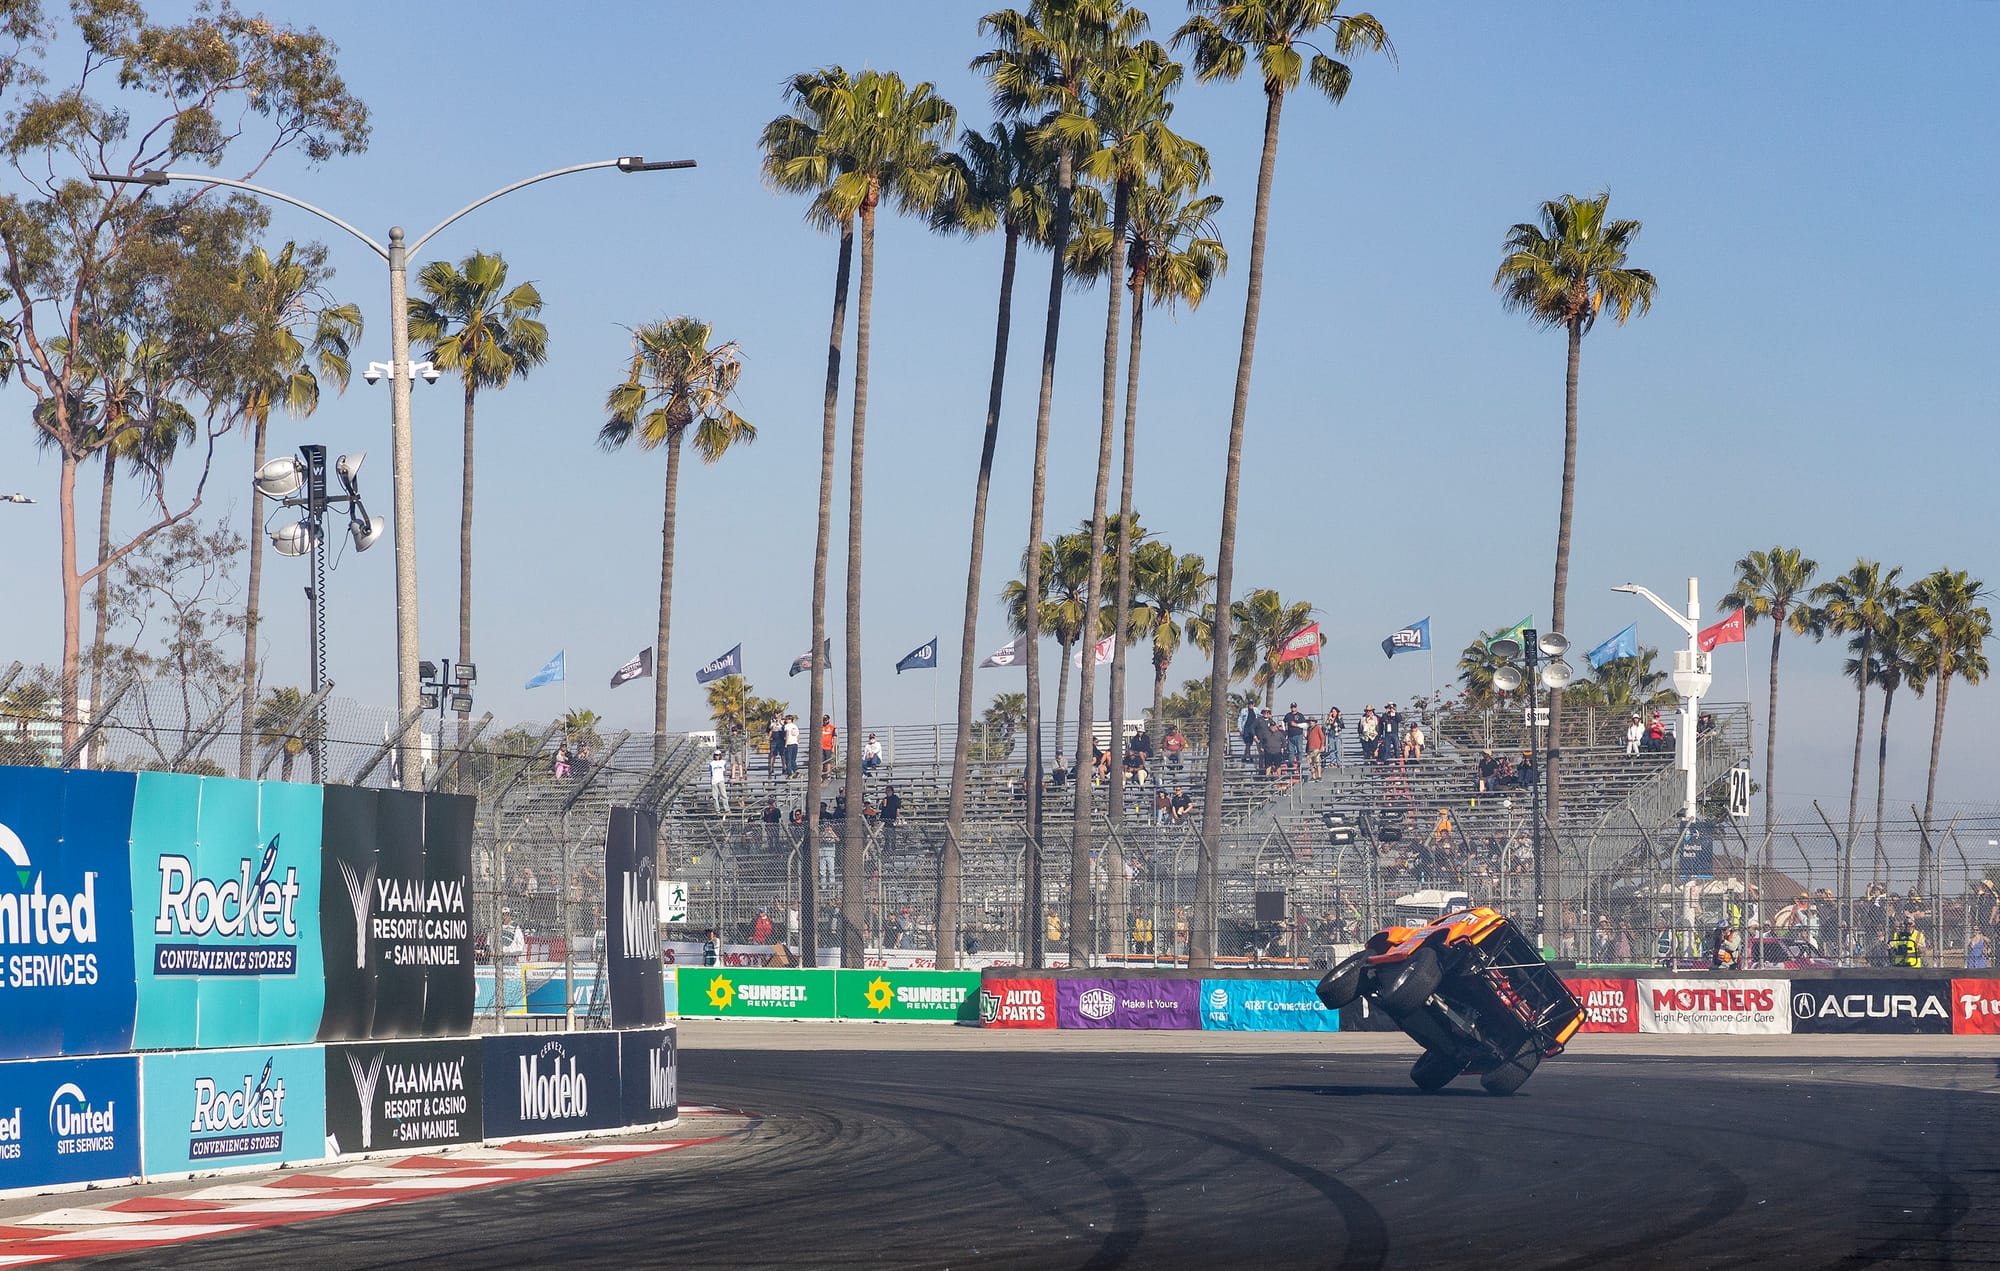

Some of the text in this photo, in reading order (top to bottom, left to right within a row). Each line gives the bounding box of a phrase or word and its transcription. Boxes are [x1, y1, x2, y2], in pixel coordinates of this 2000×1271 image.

[1732, 770, 1747, 813] 24
[155, 848, 299, 938] Rocket
[373, 918, 467, 939] RESORT & CASINO
[160, 950, 292, 969] CONVENIENCE STORES
[385, 950, 392, 960] AT
[394, 945, 415, 965] SAN
[417, 945, 460, 965] MANUEL
[9, 954, 98, 988] SERVICES
[738, 984, 805, 1001] SUNBELT
[897, 986, 967, 1003] SUNBELT
[1006, 990, 1042, 1005] AUTO
[1082, 991, 1114, 1004] COOLER
[1587, 990, 1624, 1006] AUTO
[1652, 988, 1774, 1012] MOTHERS
[747, 1000, 796, 1008] RENTALS
[1002, 1006, 1045, 1021] PARTS
[1082, 1003, 1113, 1017] MASTER
[1122, 999, 1178, 1009] Make It Yours
[1245, 1000, 1327, 1011] AT&T Connected Ca
[1818, 995, 1949, 1018] ACURA
[1209, 1011, 1229, 1021] AT&T
[1585, 1007, 1628, 1023] PARTS
[1654, 1012, 1774, 1023] High Performance Car Care
[540, 1040, 566, 1059] CERVEZA
[519, 1054, 587, 1121] Modelo
[190, 1074, 286, 1132] Rocket
[385, 1095, 467, 1119] RESORT & CASINO
[56, 1101, 114, 1137] United
[392, 1119, 460, 1141] AT SAN MANUEL
[57, 1135, 114, 1155] SITE SERVICES
[193, 1135, 280, 1155] CONVENIENCE STORES
